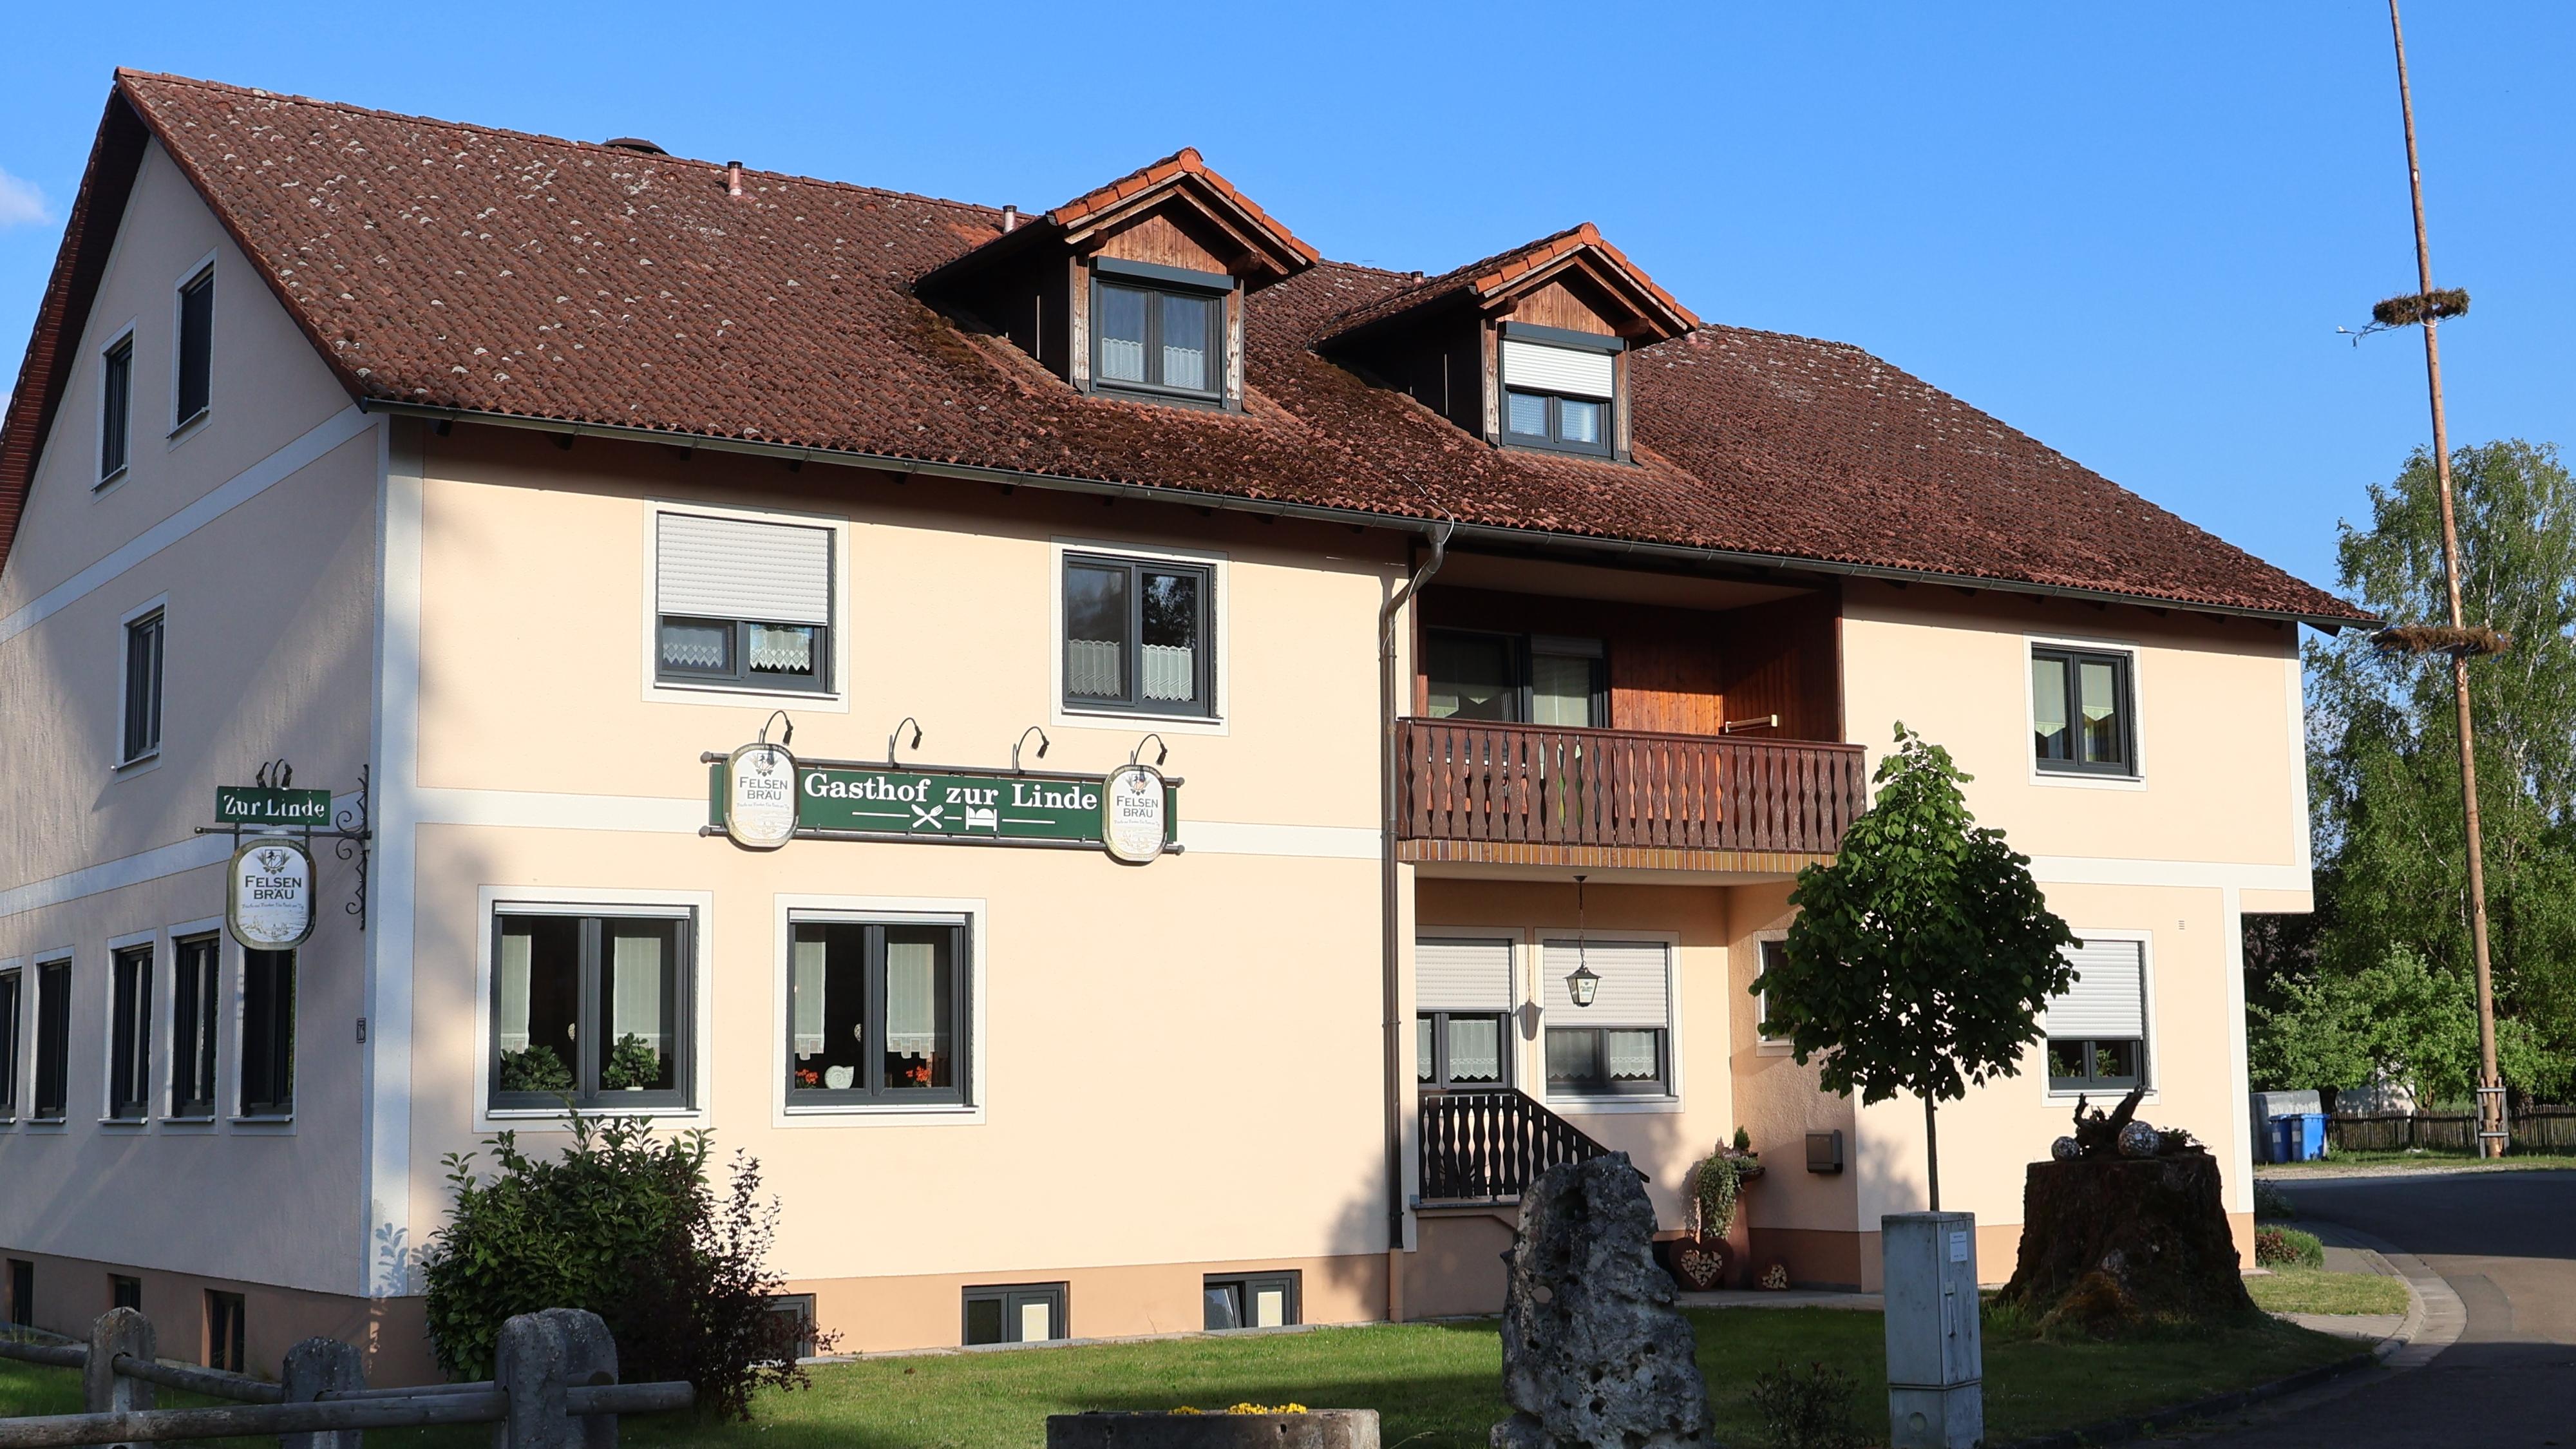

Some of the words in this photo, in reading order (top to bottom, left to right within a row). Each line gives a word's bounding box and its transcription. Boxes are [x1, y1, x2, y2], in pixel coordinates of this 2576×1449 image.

[739, 777, 788, 790] FELSEN
[747, 790, 782, 800] BRÄU
[804, 773, 932, 802] Gasthof
[945, 787, 999, 806] zur
[1011, 783, 1097, 810] Linde
[223, 795, 261, 815] Zur
[265, 798, 325, 818] Linde
[1117, 795, 1159, 808] FELSEN
[1123, 807, 1153, 818] BRÄU
[245, 875, 302, 888] FELSEN
[254, 888, 294, 900] BRÄU
[358, 1025, 365, 1039] 16
